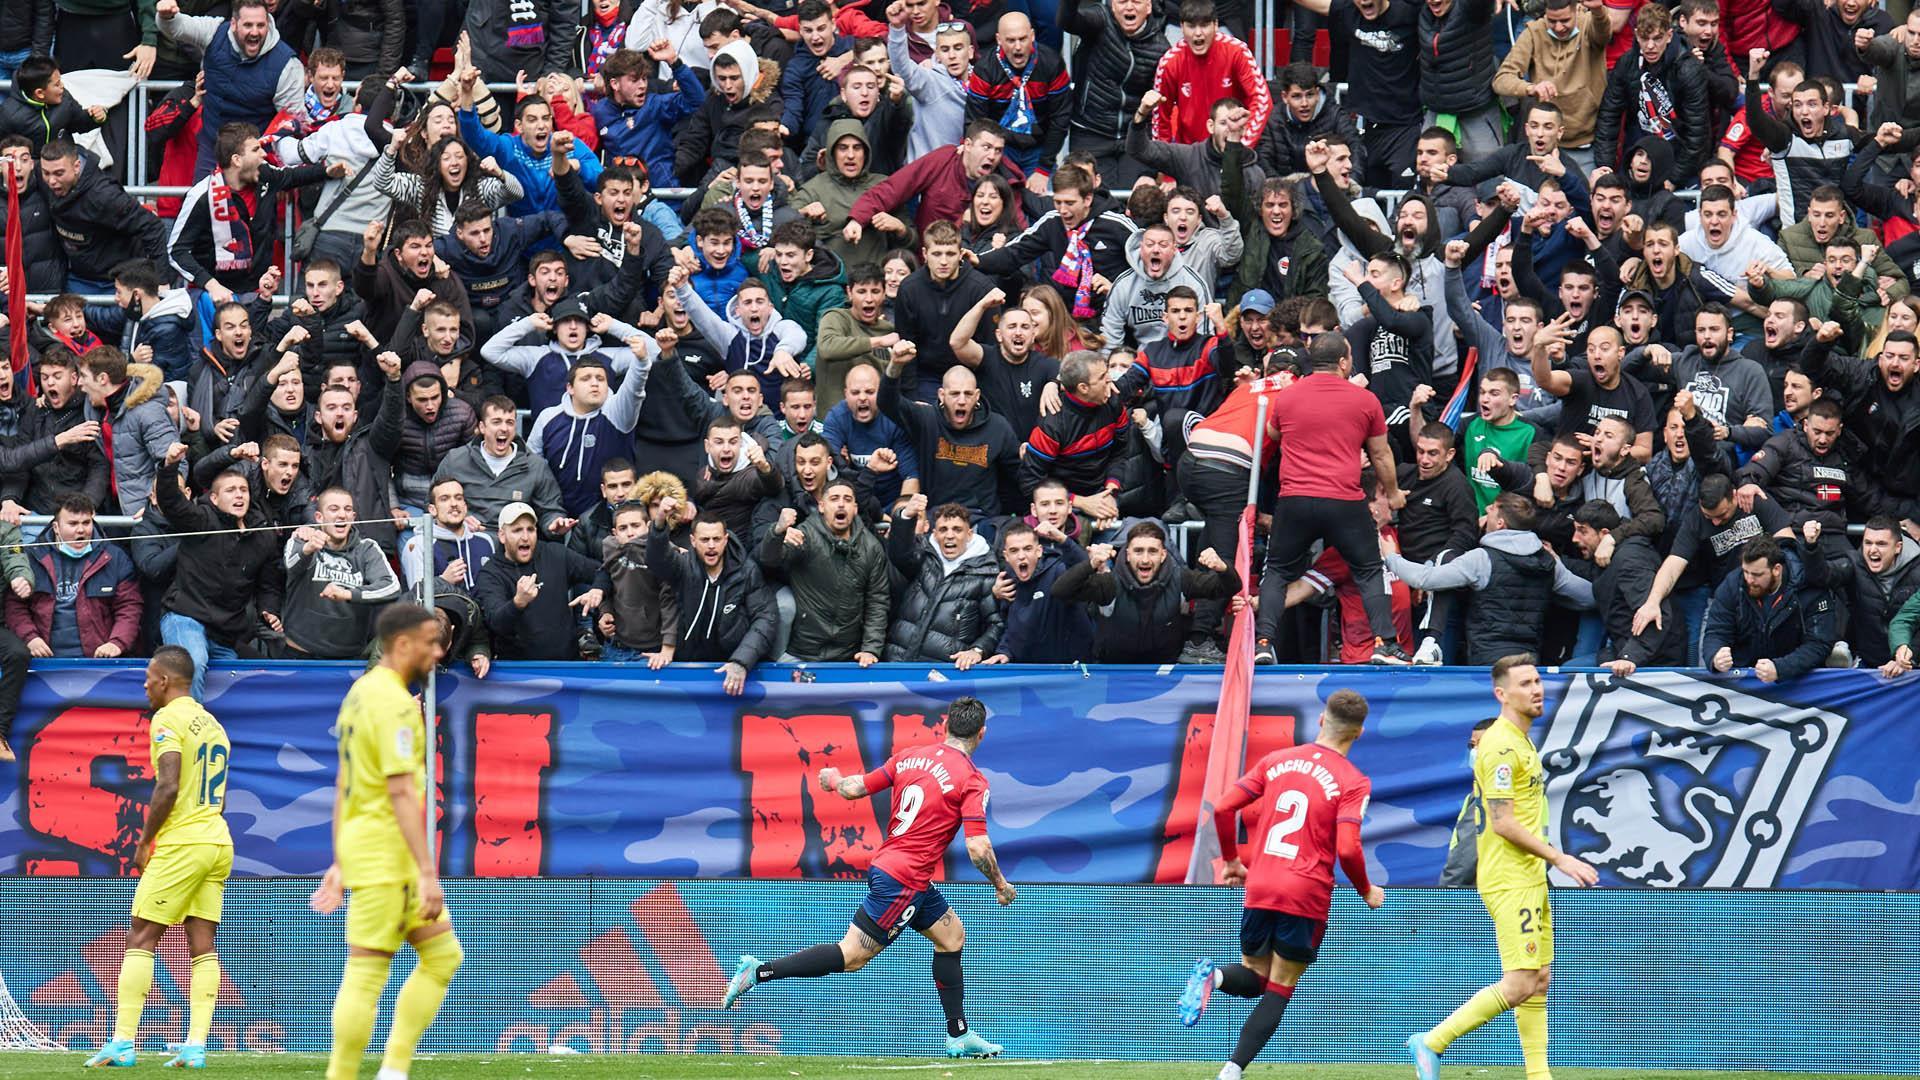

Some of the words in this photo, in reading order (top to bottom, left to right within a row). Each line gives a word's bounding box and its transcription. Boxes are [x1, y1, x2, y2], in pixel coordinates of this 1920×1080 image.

[195, 742, 228, 807] 12
[896, 757, 934, 775] CHIMY
[929, 761, 955, 794] ÁVILA
[1266, 759, 1314, 782] NACHO
[1311, 764, 1341, 801] VIDAL
[892, 784, 925, 837] 9
[1264, 789, 1309, 860] 2
[897, 905, 915, 926] 9
[1519, 907, 1543, 933] 23
[498, 1005, 784, 1054] adidas
